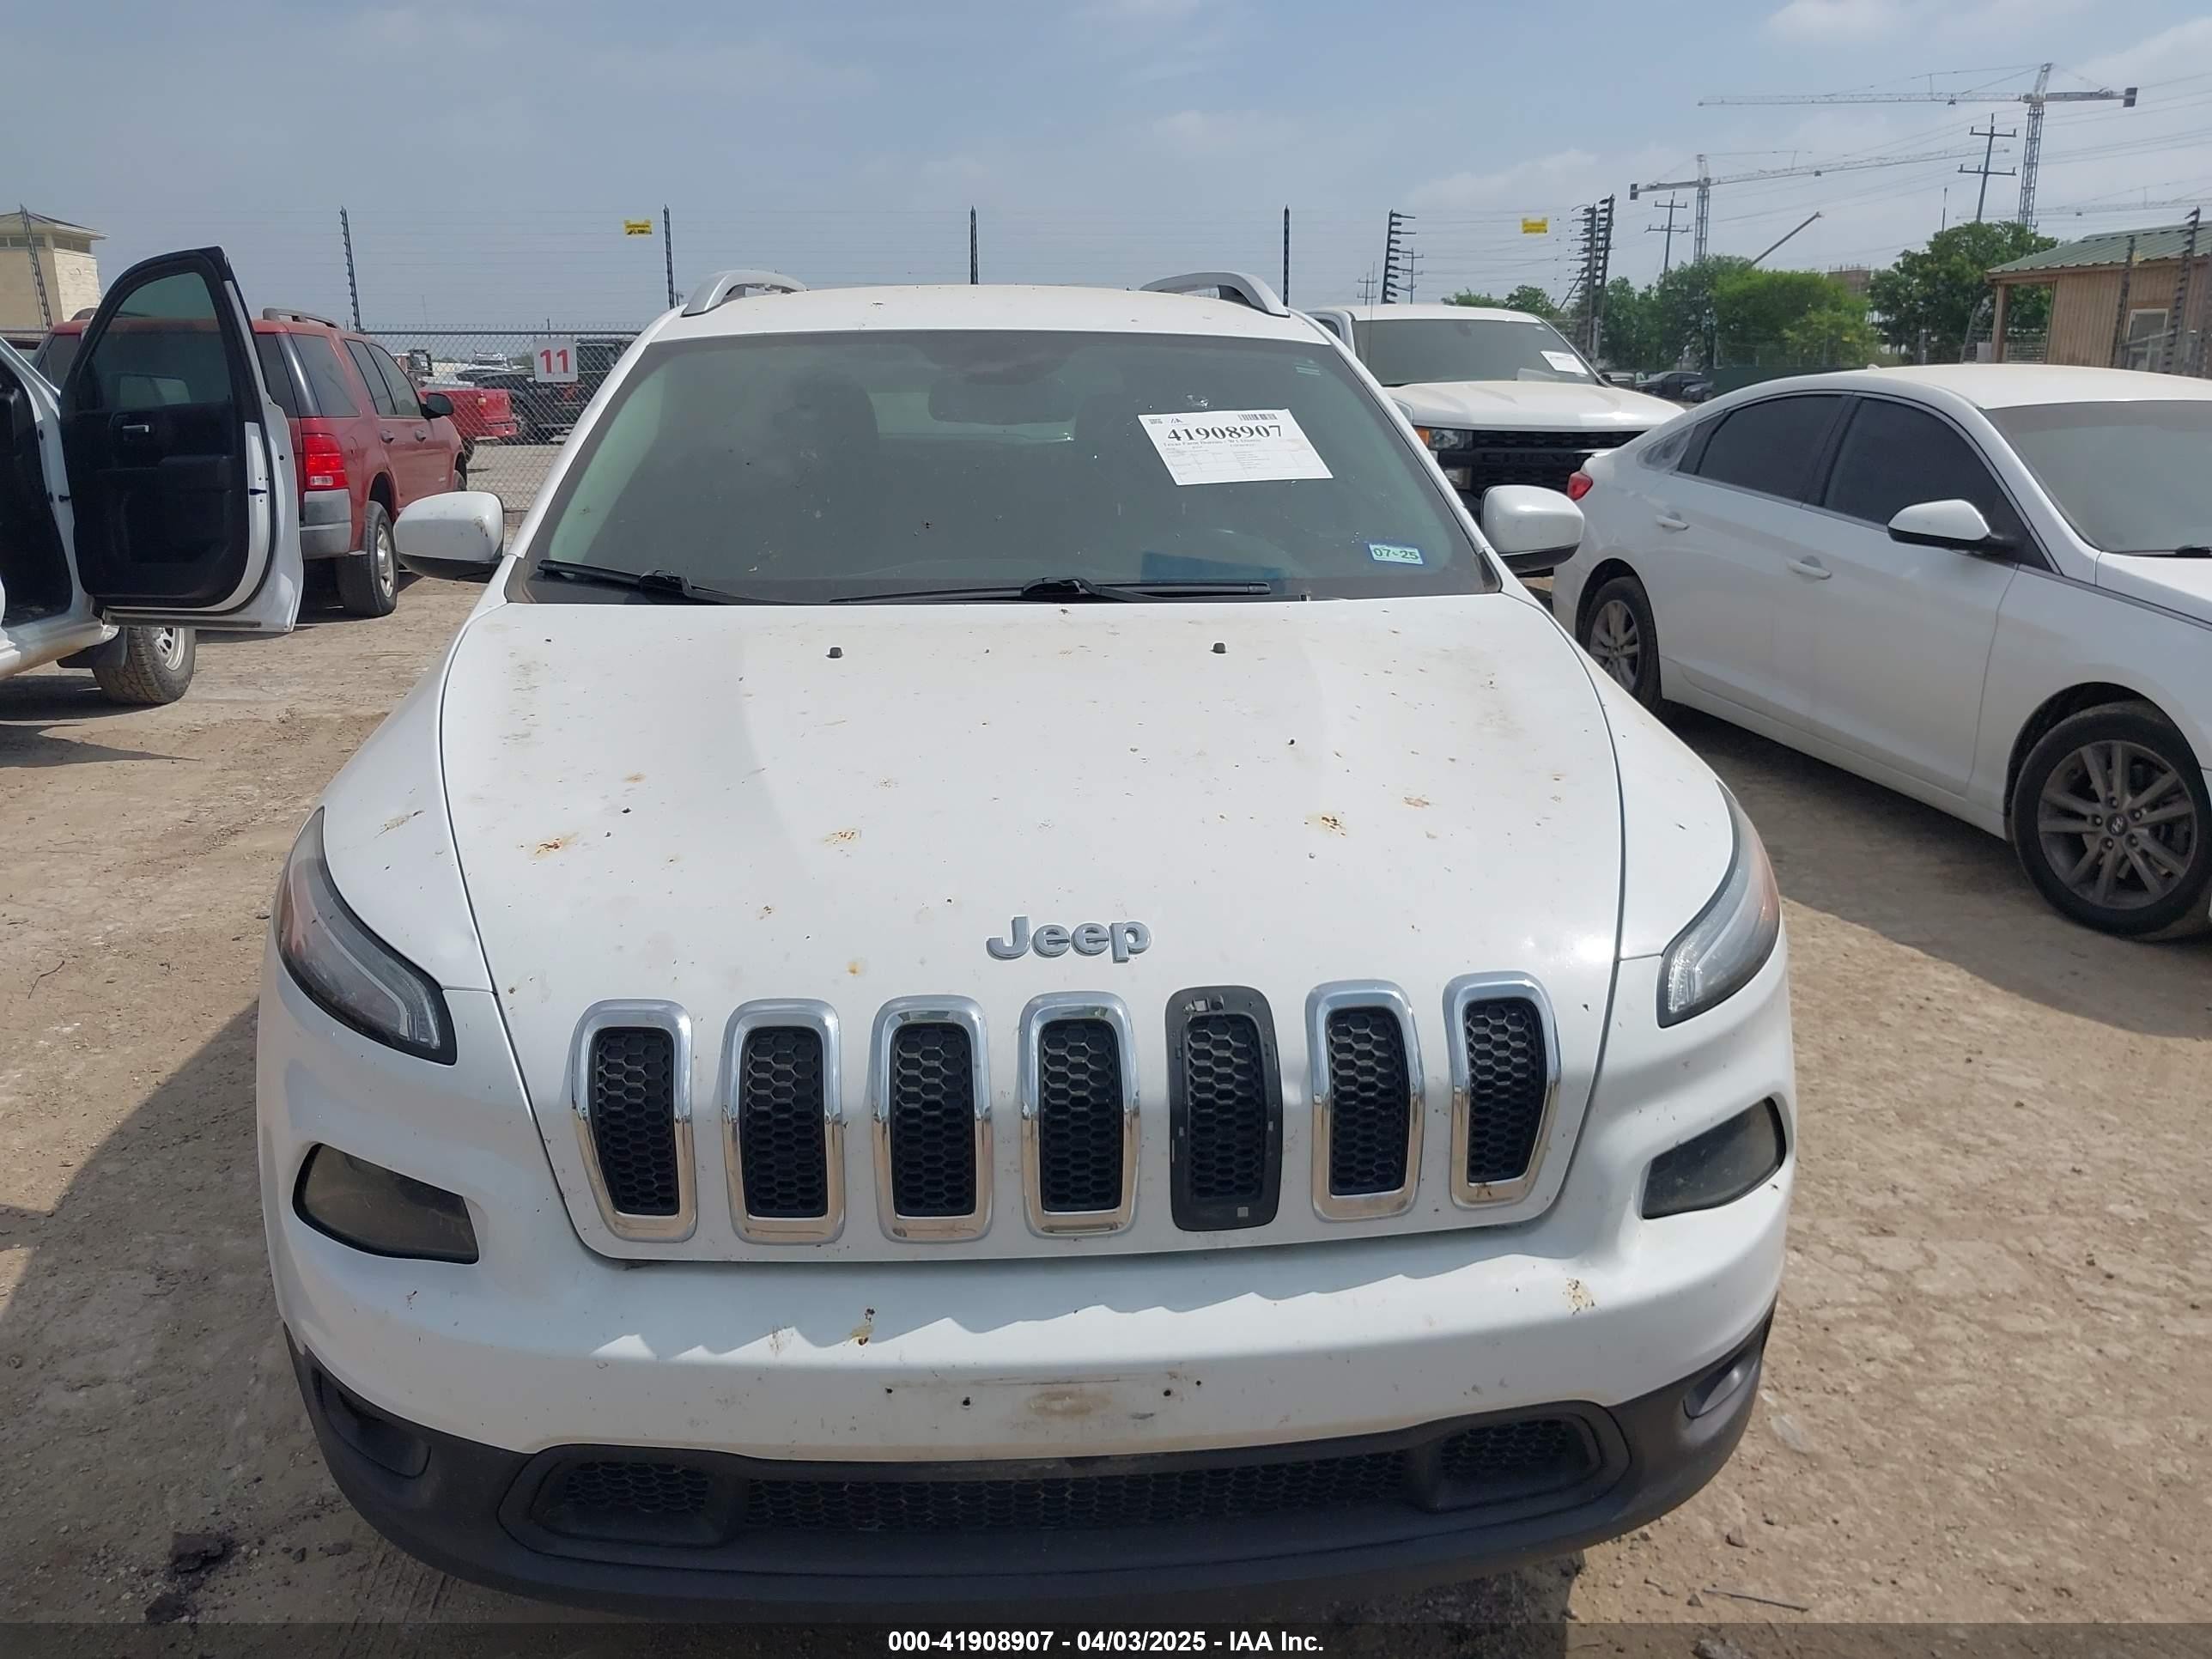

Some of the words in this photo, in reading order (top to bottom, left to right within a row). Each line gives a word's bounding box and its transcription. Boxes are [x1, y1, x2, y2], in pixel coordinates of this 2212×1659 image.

[540, 349, 568, 374] 11
[1167, 425, 1282, 441] 41908907
[1374, 548, 1419, 560] 07-25
[987, 915, 1152, 963] Jeep
